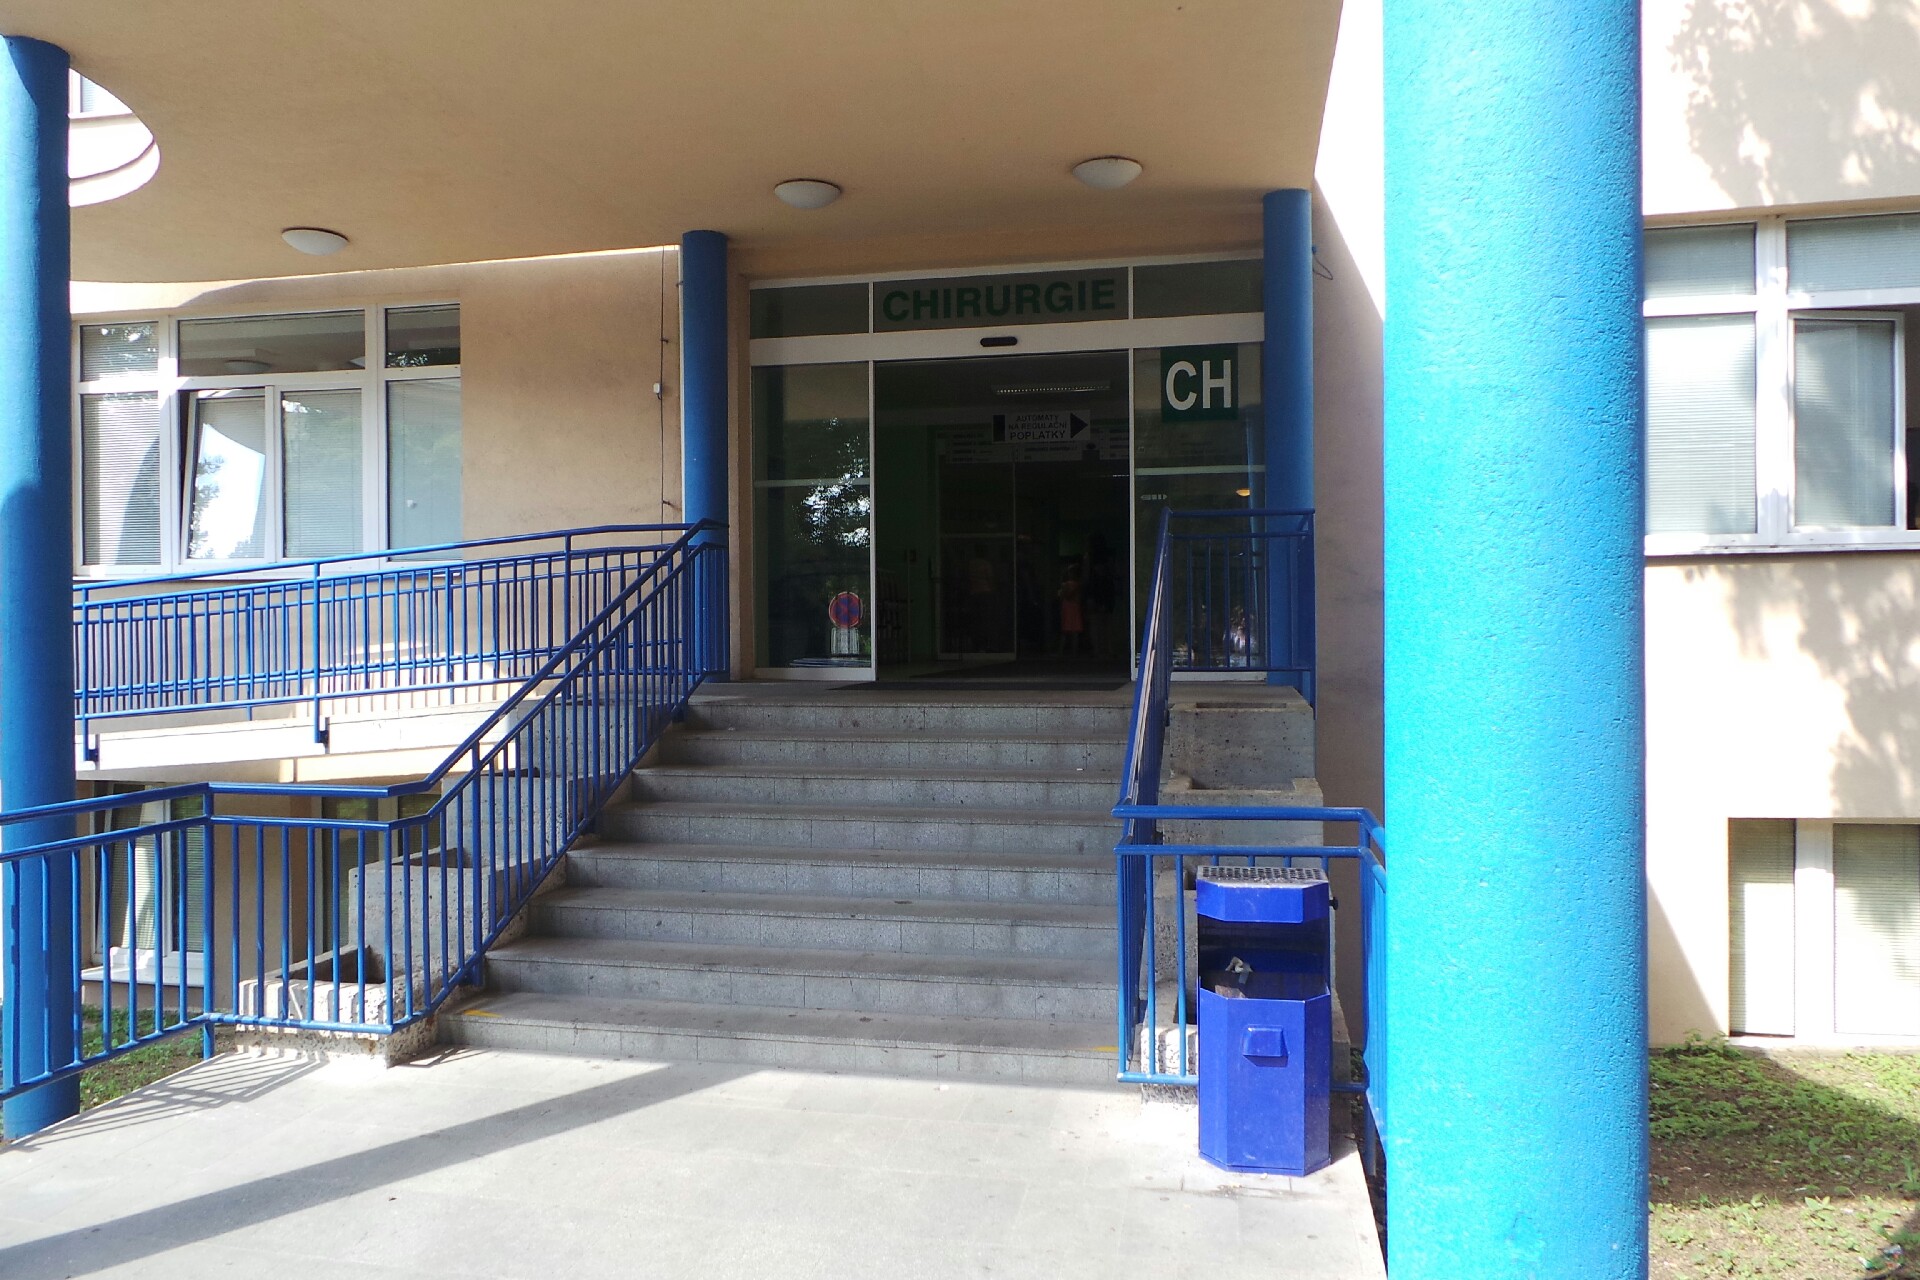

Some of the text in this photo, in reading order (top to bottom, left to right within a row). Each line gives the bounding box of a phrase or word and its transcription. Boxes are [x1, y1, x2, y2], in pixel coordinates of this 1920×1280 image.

[882, 278, 1116, 321] CHIRURGIE
[1165, 360, 1231, 410] CH
[1016, 414, 1059, 422] AUTOMATY
[1010, 430, 1065, 440] POPLATKY
